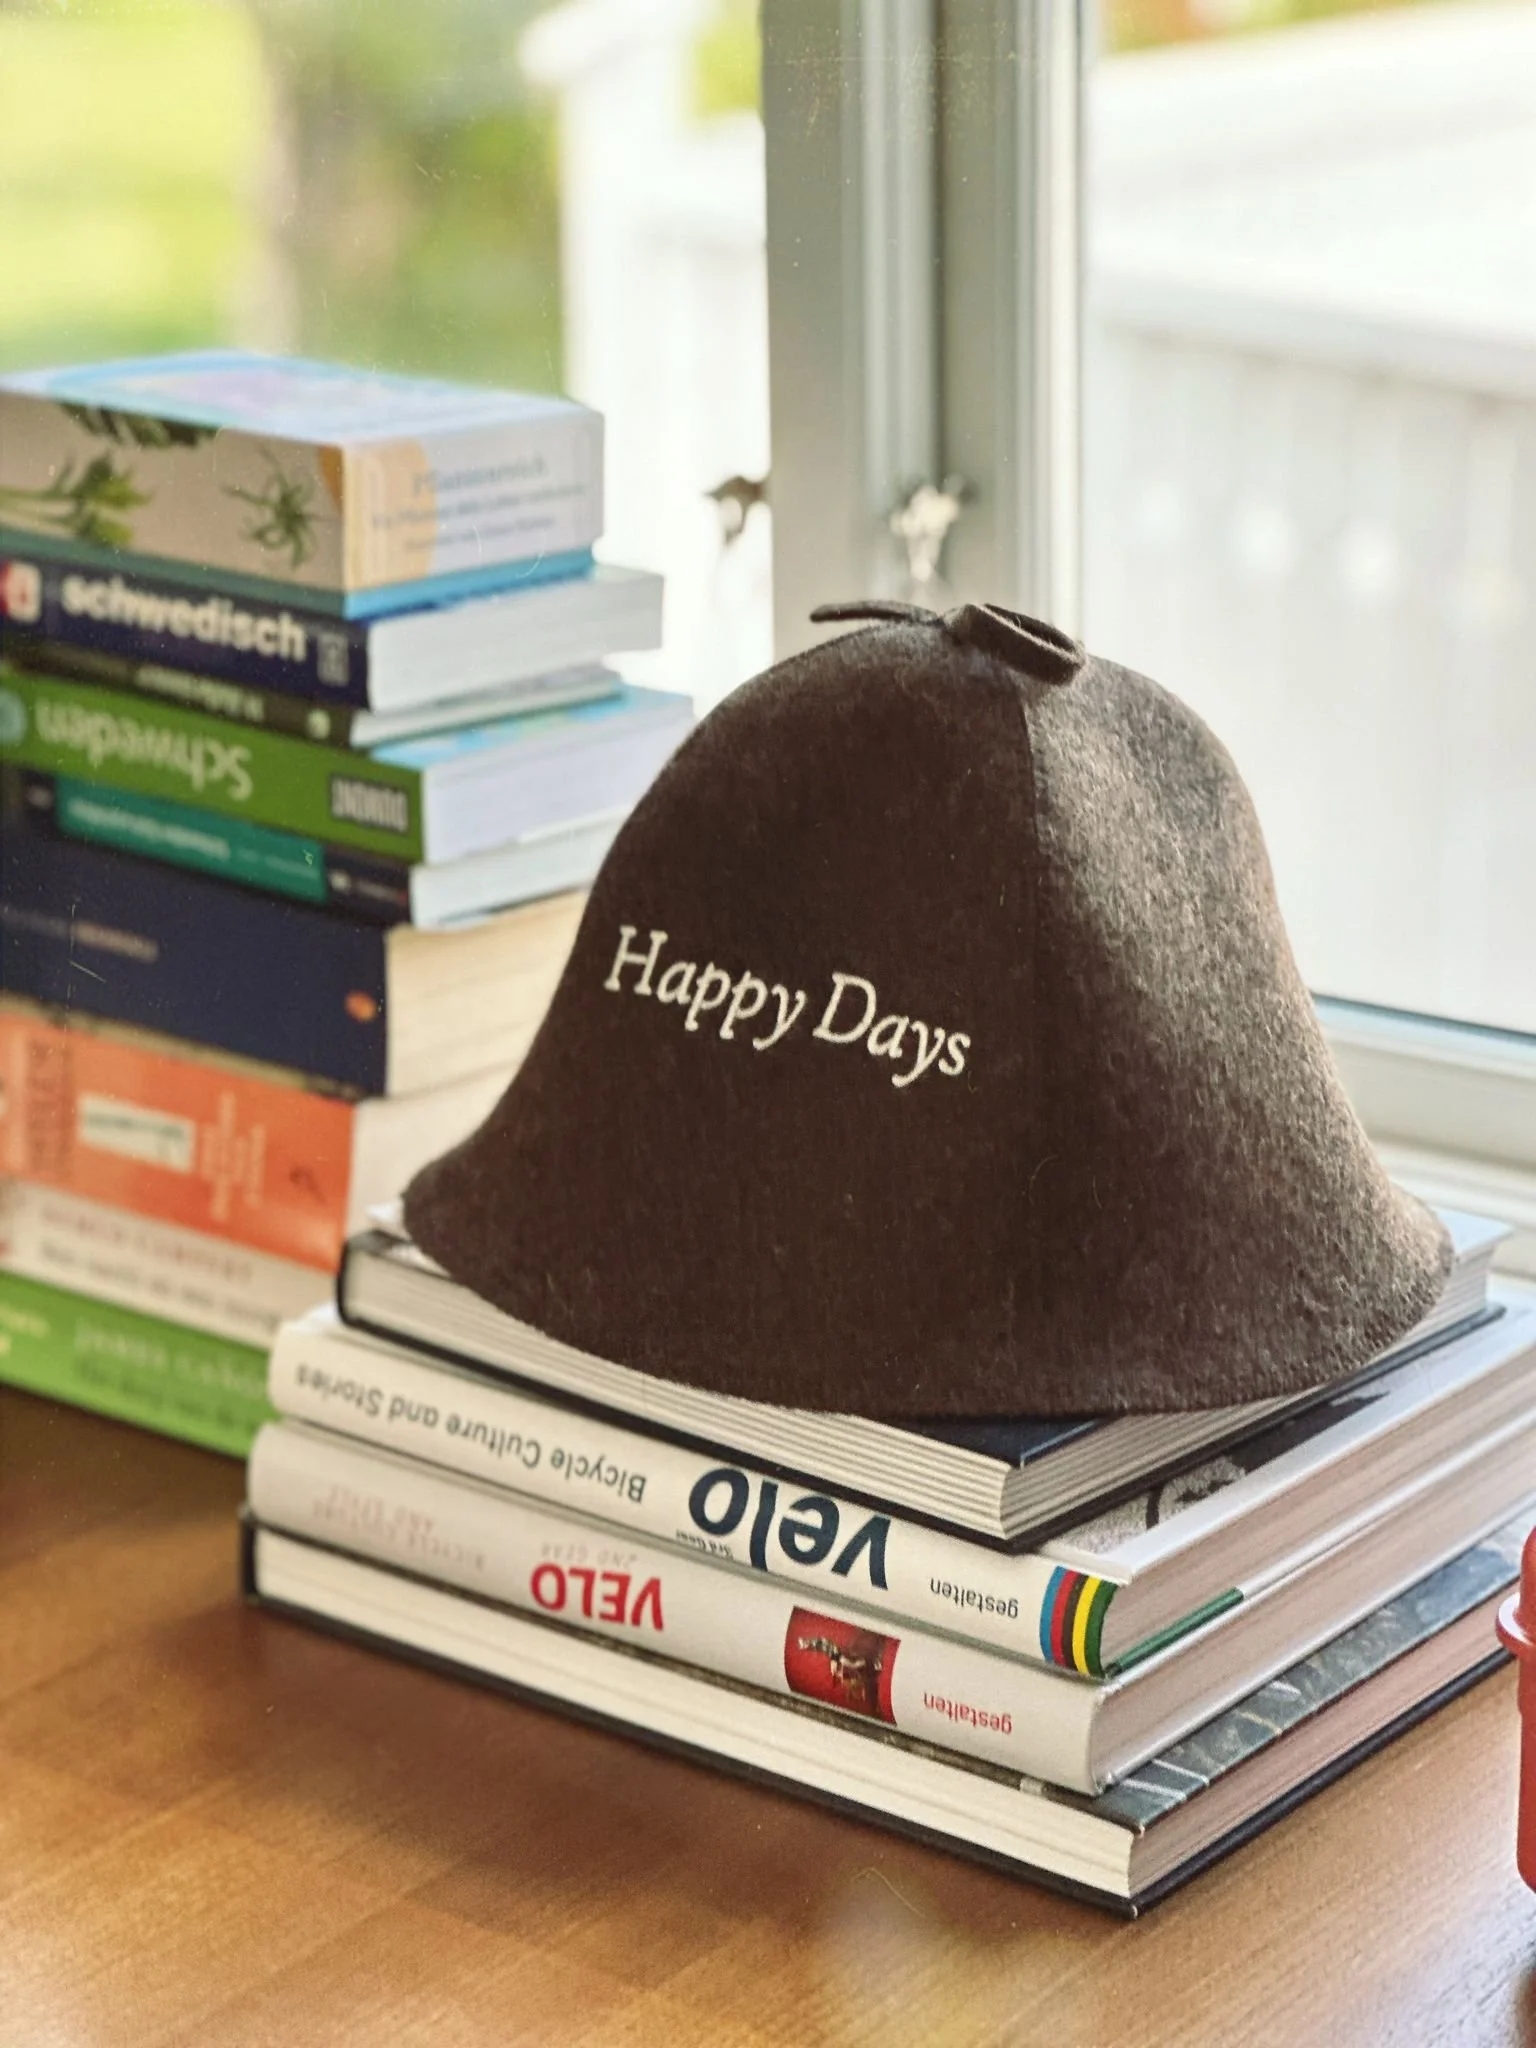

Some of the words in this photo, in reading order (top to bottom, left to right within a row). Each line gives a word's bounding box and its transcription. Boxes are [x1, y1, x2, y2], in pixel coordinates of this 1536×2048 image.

[62, 576, 307, 661] schwedisch
[604, 926, 808, 1051] Happy
[812, 972, 971, 1087] Days
[296, 1363, 384, 1418] Stories
[389, 1396, 438, 1431] and
[446, 1415, 541, 1468] Culture
[551, 1446, 647, 1503] Bicycle
[539, 1542, 590, 1564] GEAR
[688, 1467, 892, 1592] velo
[597, 1547, 639, 1569] 2ND
[531, 1562, 665, 1632] VELO
[929, 1577, 1019, 1620] gestalten
[923, 1691, 1013, 1735] gestalten
